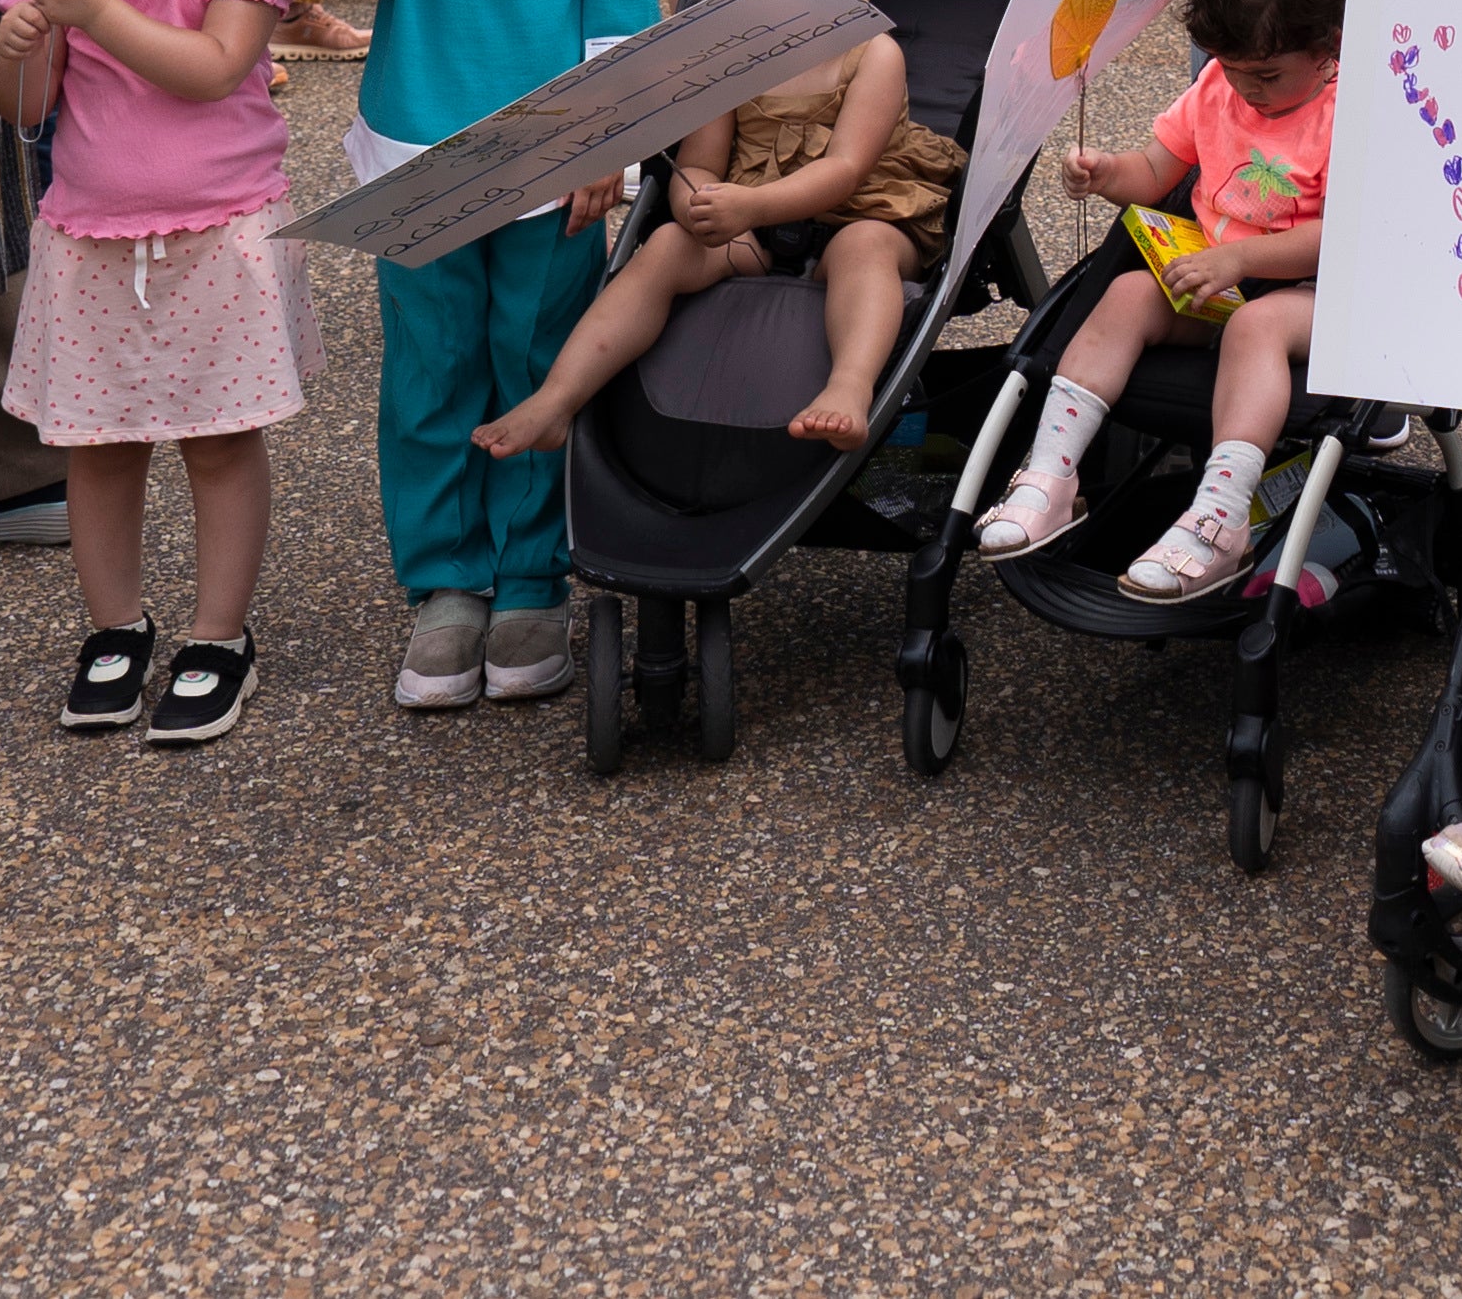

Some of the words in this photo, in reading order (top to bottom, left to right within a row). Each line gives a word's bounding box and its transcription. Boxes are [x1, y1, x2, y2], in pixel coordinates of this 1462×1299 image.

[668, 23, 775, 74] with
[384, 187, 525, 257] acting
[539, 121, 627, 164] like
